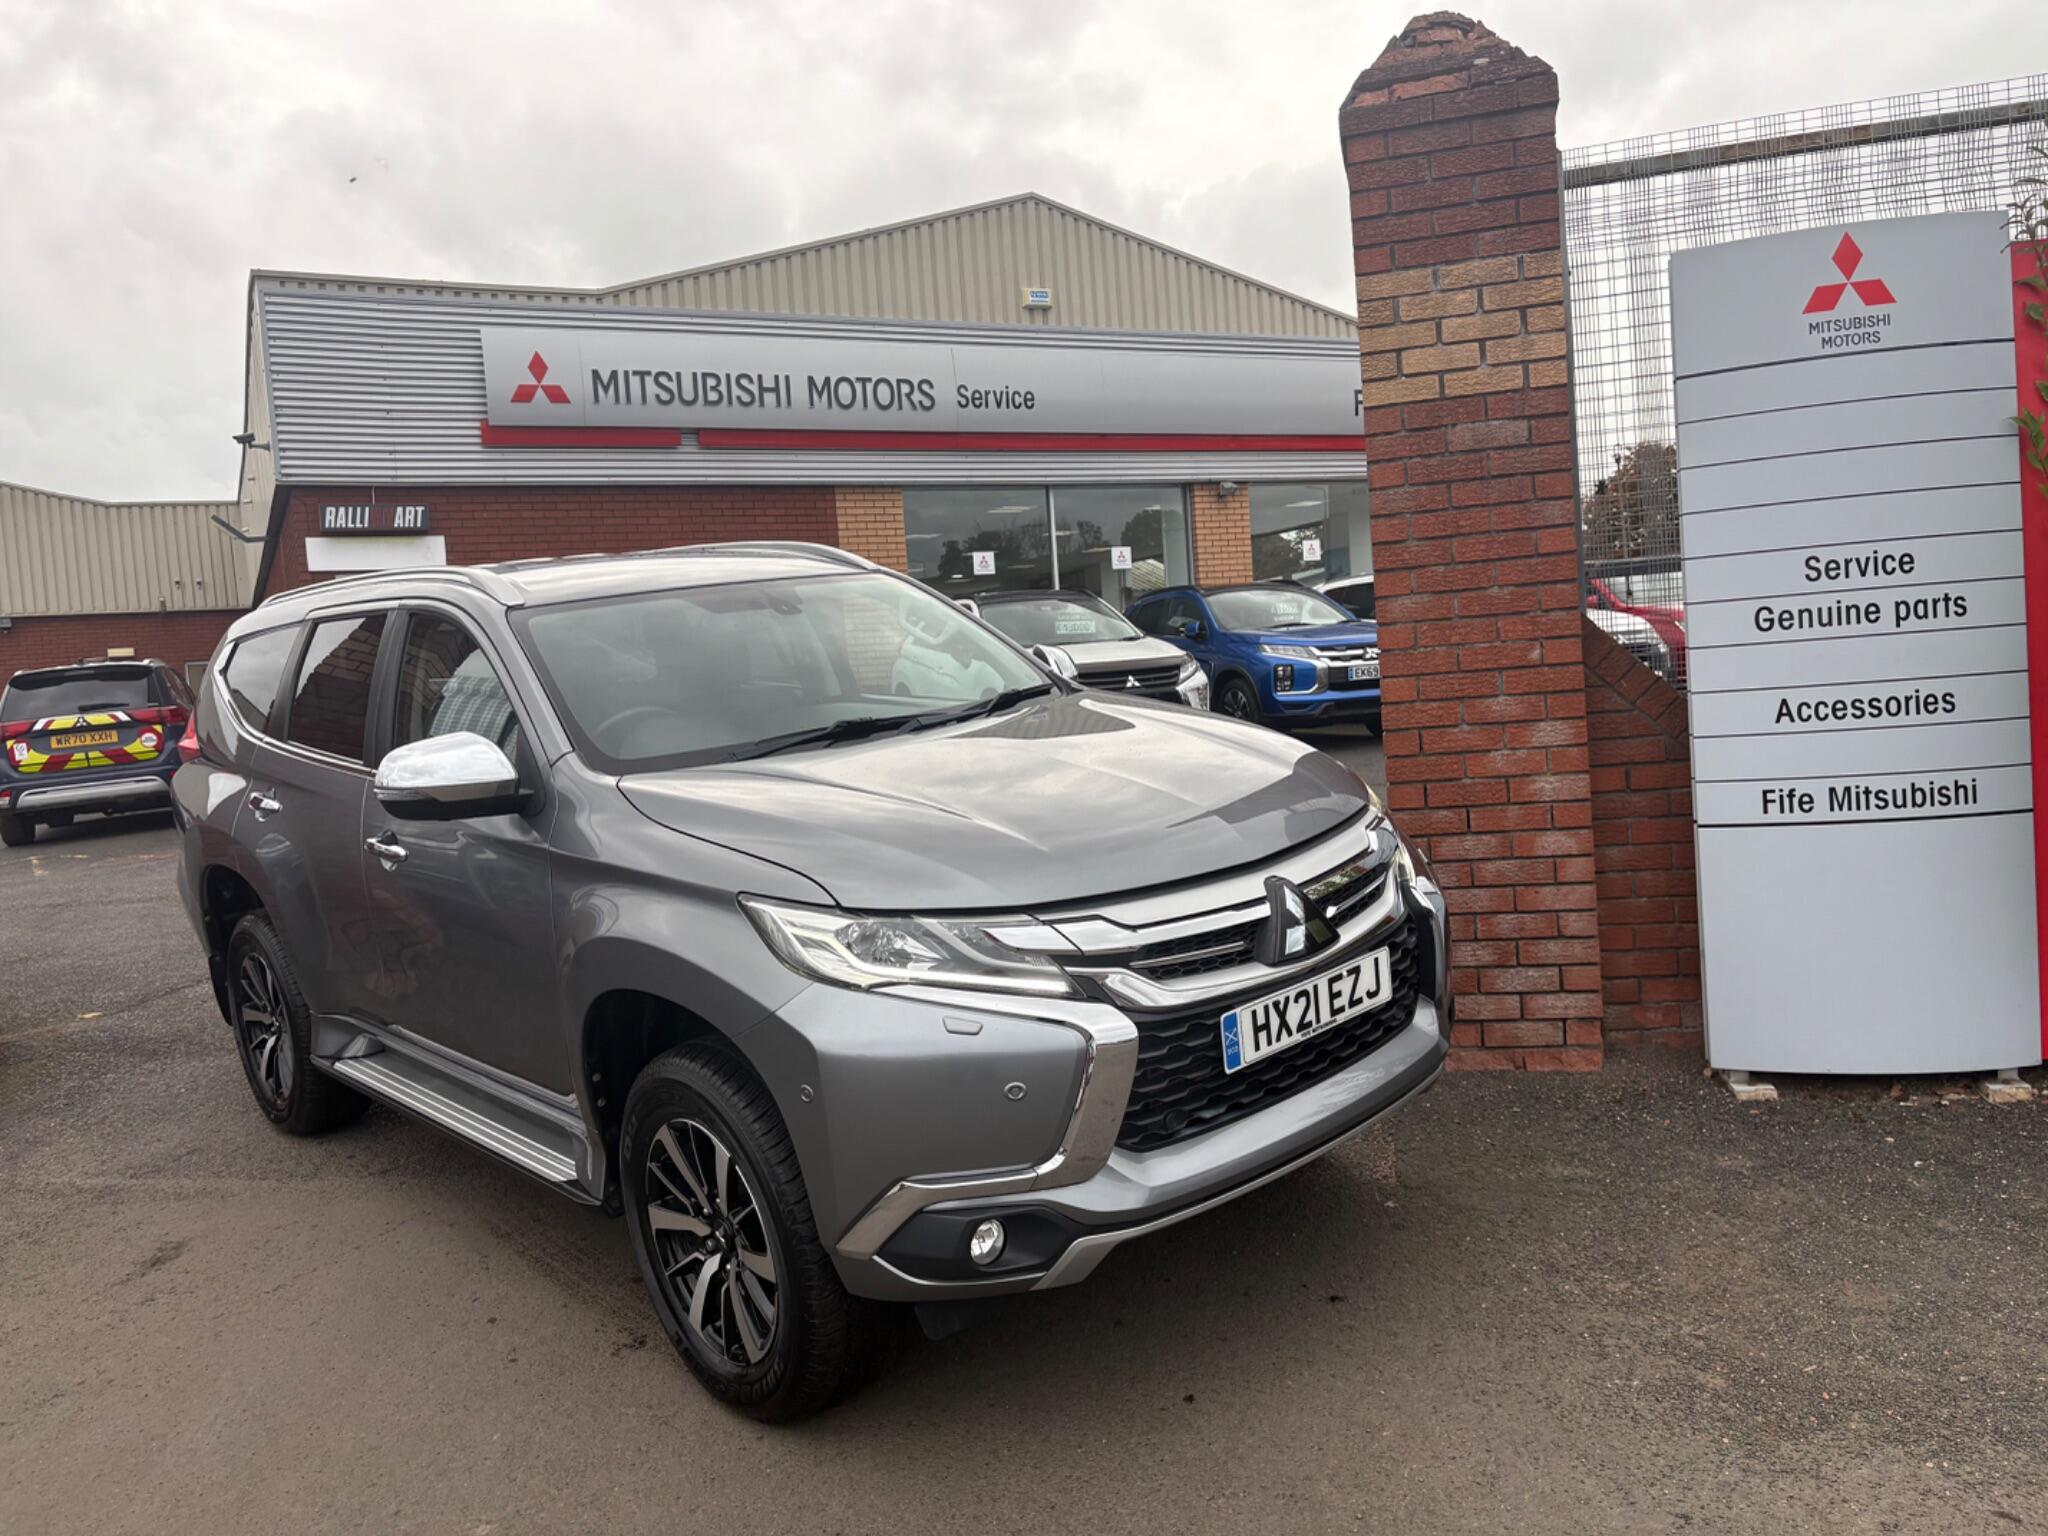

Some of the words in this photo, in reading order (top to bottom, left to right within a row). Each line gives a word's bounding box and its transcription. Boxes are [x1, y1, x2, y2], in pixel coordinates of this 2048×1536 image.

[1808, 313, 1891, 335] MITSUBISHI
[1821, 331, 1881, 350] MOTORS
[591, 369, 792, 408] MITSUBISHI
[807, 375, 936, 411] MOTORS
[956, 384, 1036, 410] Service
[1804, 550, 1915, 582] Service
[1754, 600, 1881, 632] Genuine
[1895, 592, 1968, 628] parts
[1775, 689, 1957, 724] Accessories
[55, 735, 87, 746] WR70
[89, 731, 113, 743] XXH
[1761, 788, 1815, 815] Fife
[1828, 778, 1978, 812] Mitsubishi
[1251, 984, 1321, 1053] HX21
[1327, 957, 1381, 1018] EZJ
